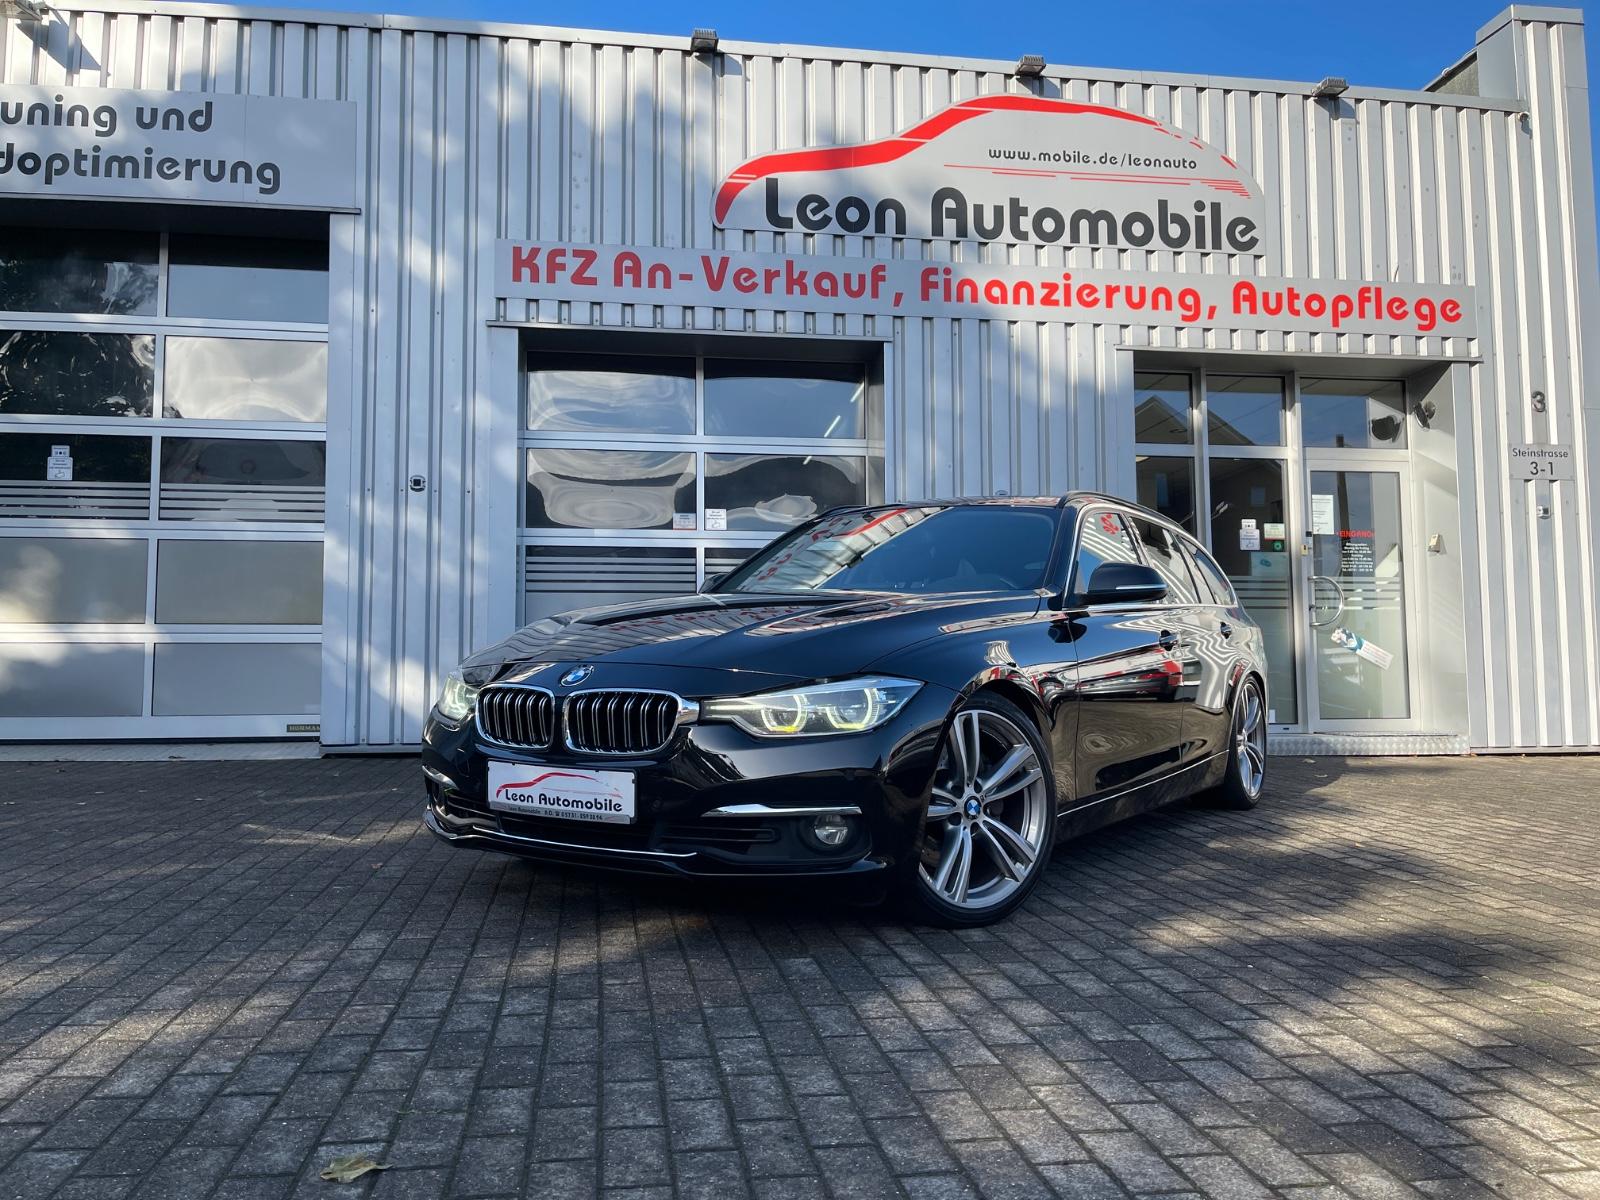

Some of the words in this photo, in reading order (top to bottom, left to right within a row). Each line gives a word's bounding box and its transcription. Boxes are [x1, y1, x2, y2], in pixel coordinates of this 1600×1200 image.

[136, 101, 213, 132] und
[988, 149, 1197, 169] www.mobile.de/leonauto
[766, 178, 907, 235] Leon
[932, 187, 1260, 252] Automobile
[920, 267, 1217, 322] Finanzierung,
[1233, 281, 1462, 331] Autopflege
[1531, 391, 1546, 413] 3
[1512, 448, 1569, 458] Steinstrasse
[1530, 461, 1554, 476] 3-1
[505, 789, 534, 803] Leon
[538, 793, 623, 812] Automobile
